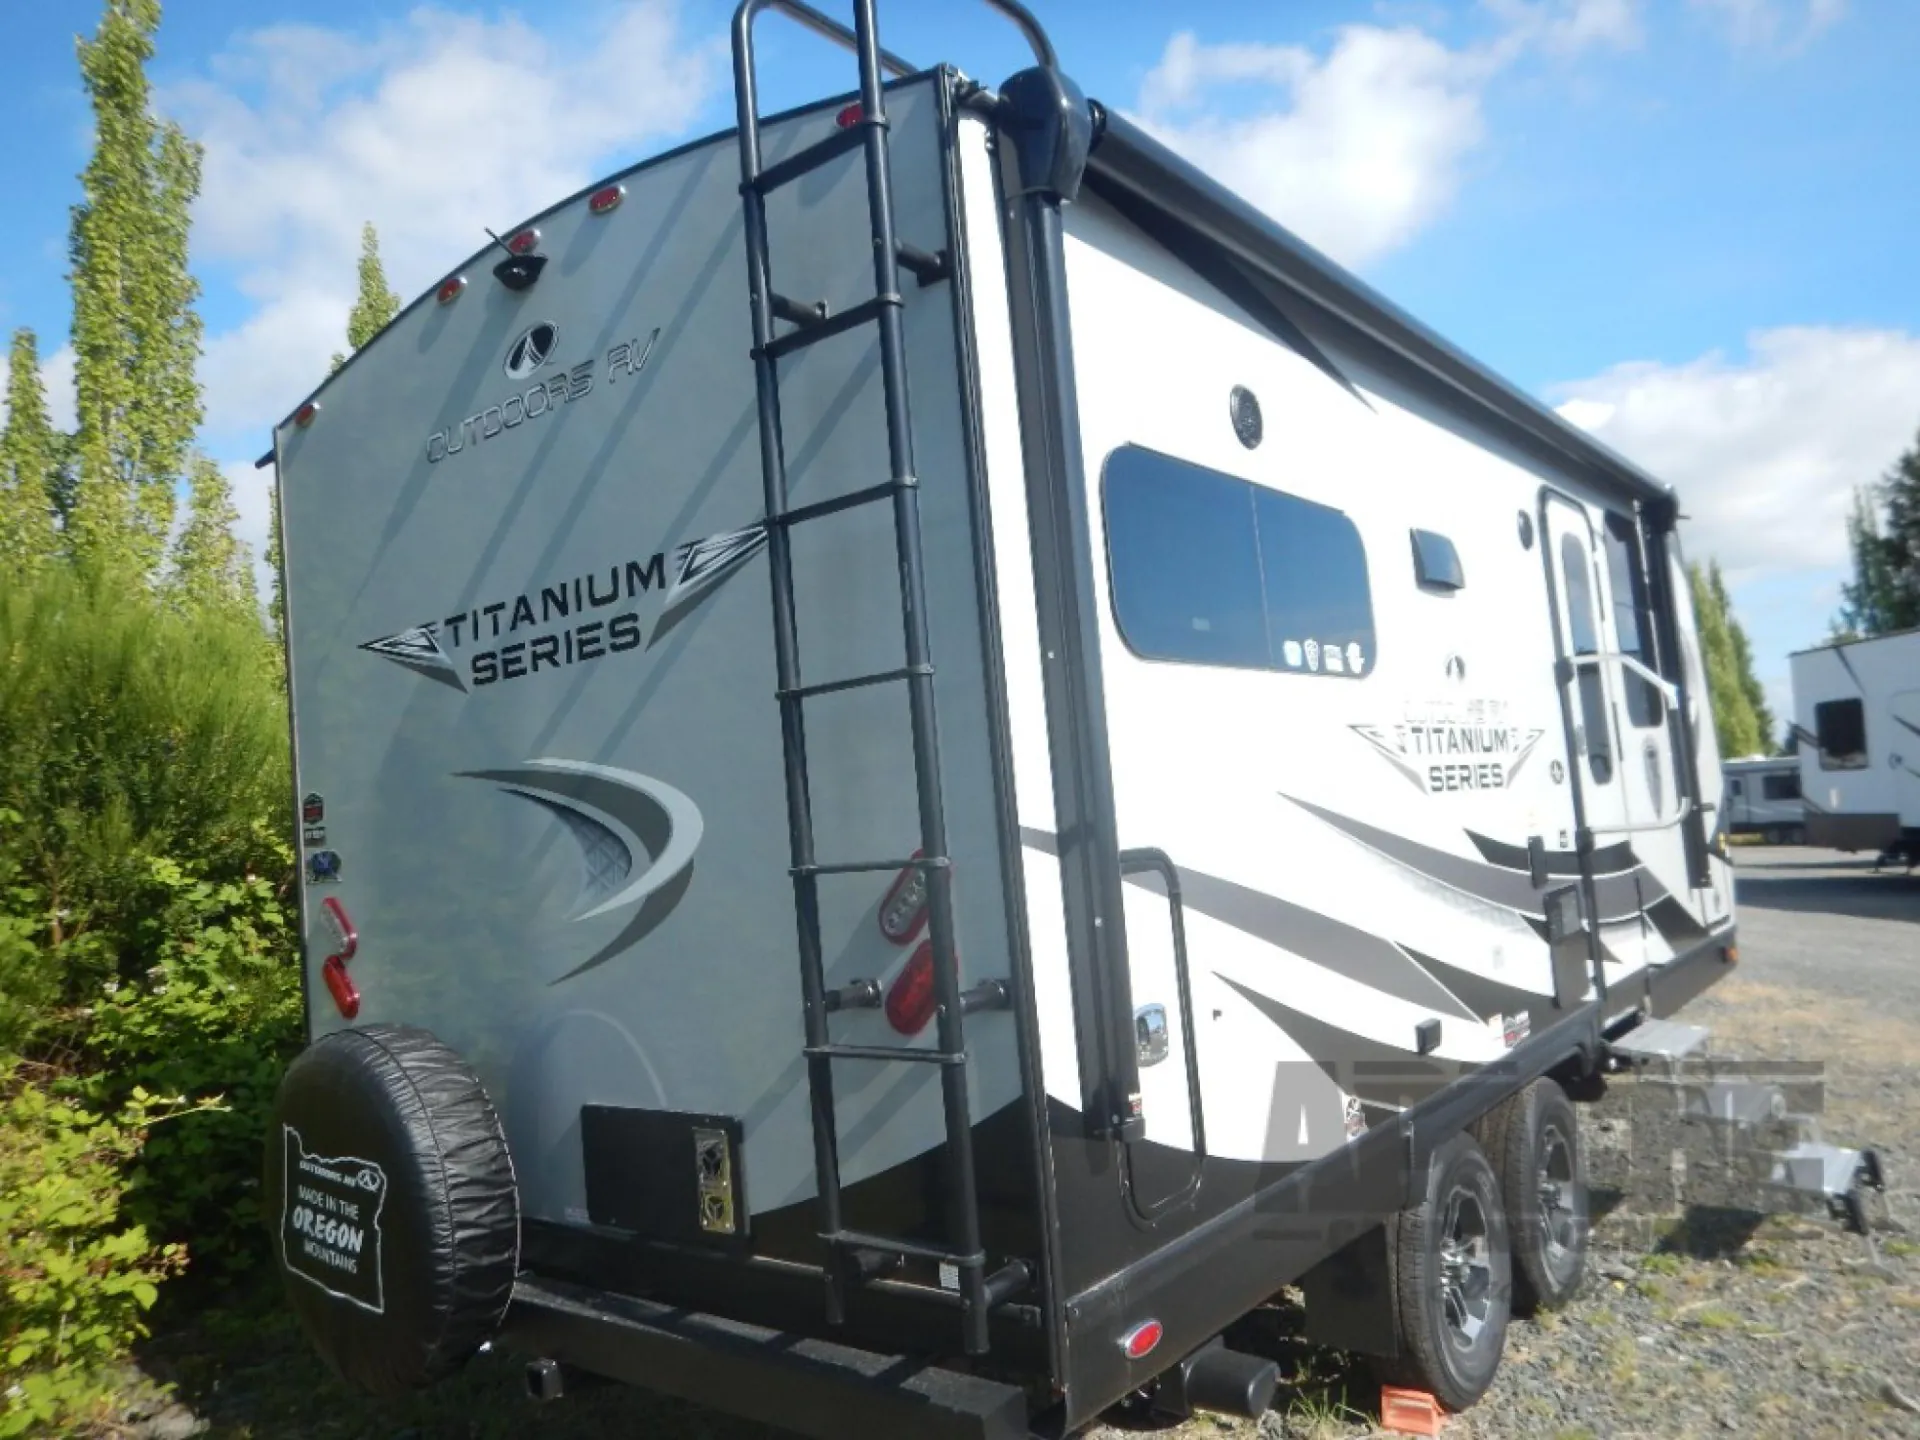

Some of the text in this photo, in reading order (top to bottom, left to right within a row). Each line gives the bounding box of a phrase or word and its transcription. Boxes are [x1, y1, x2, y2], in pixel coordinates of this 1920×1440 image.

[427, 327, 661, 464] OUTDOORS RV
[443, 552, 667, 648] TITANIUM
[471, 611, 641, 686] SERIES
[1411, 726, 1509, 755] TITANIUM
[1428, 763, 1504, 792] SERIES
[298, 1184, 360, 1221] MADE IN THE
[292, 1205, 365, 1253] OREGON
[304, 1238, 358, 1275] MOUNTAINS
